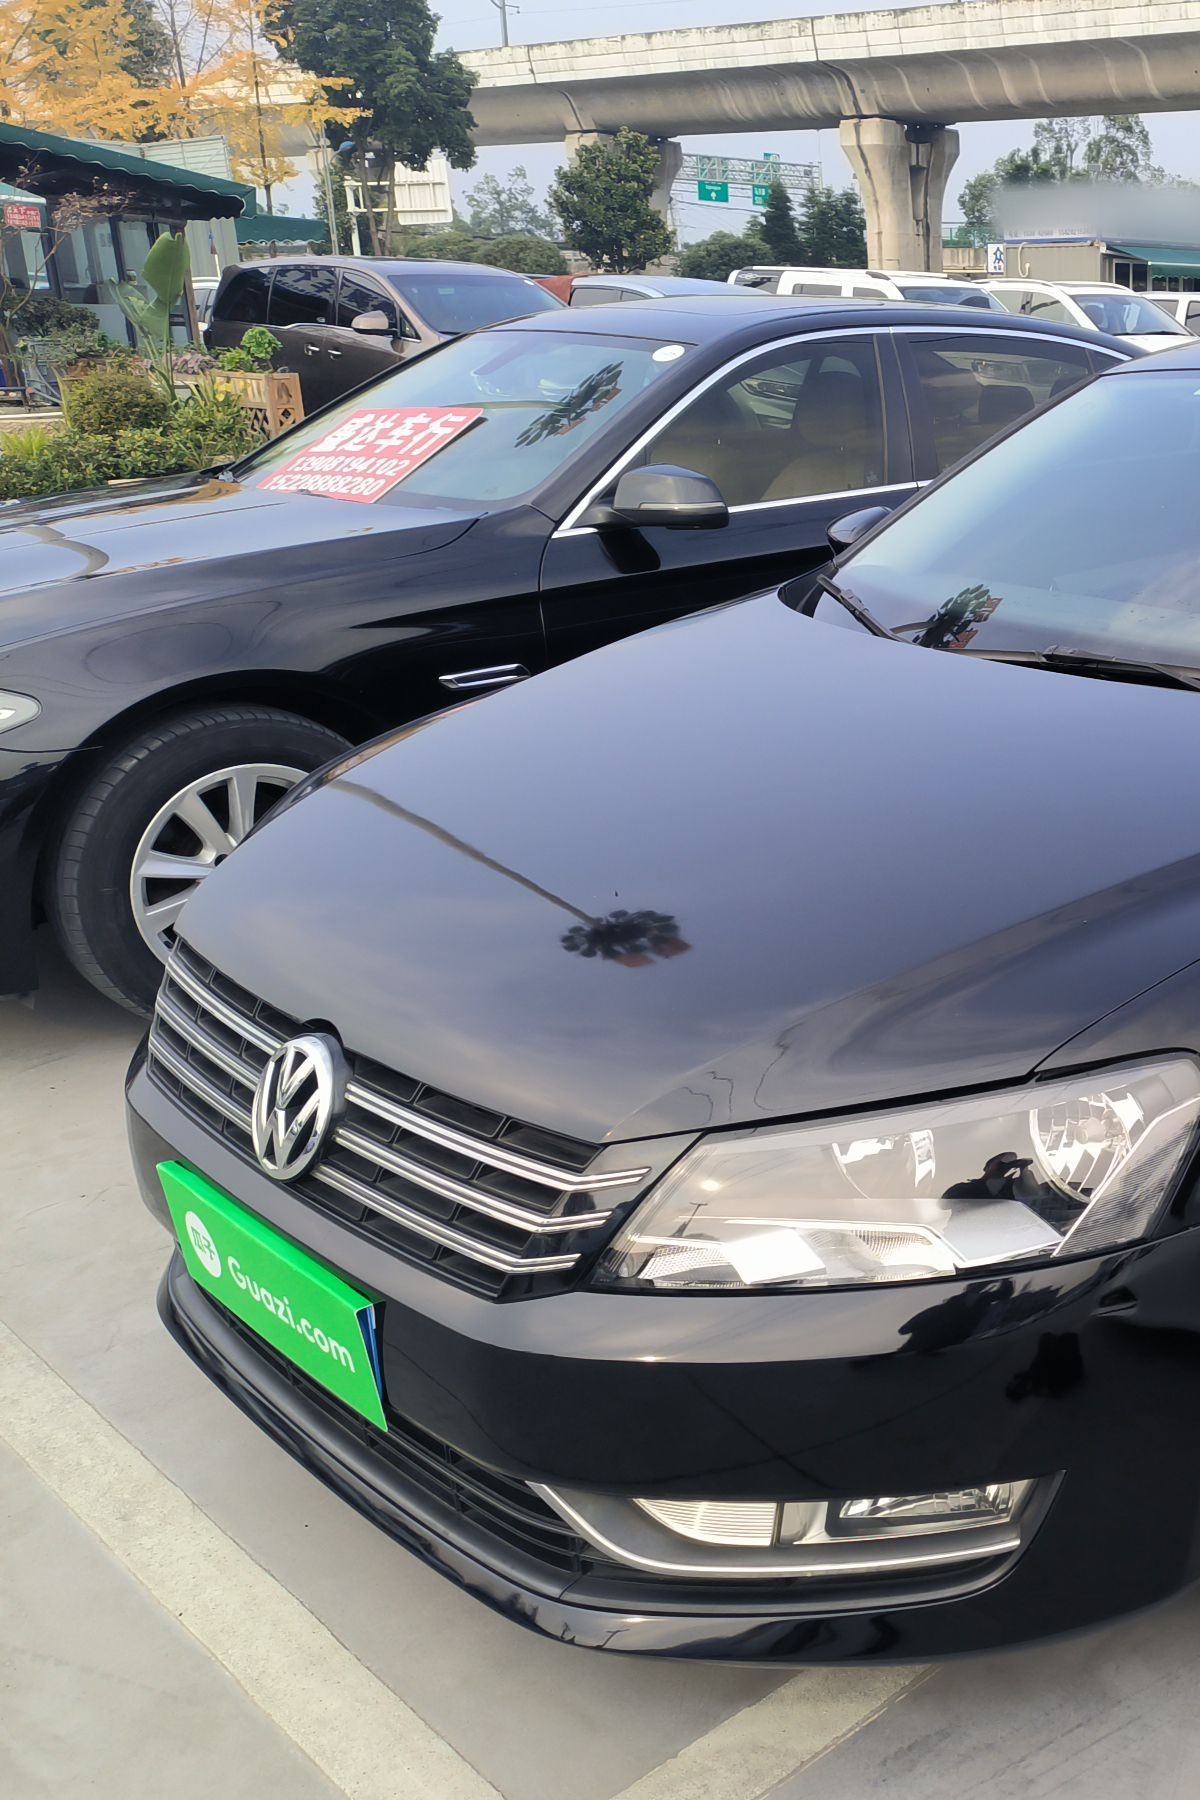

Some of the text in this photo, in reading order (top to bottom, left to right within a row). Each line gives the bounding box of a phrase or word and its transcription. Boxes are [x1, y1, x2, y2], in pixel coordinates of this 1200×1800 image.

[286, 455, 412, 477] 13908194102
[264, 473, 386, 496] 15228888280
[227, 1255, 356, 1374] Guazi.com
